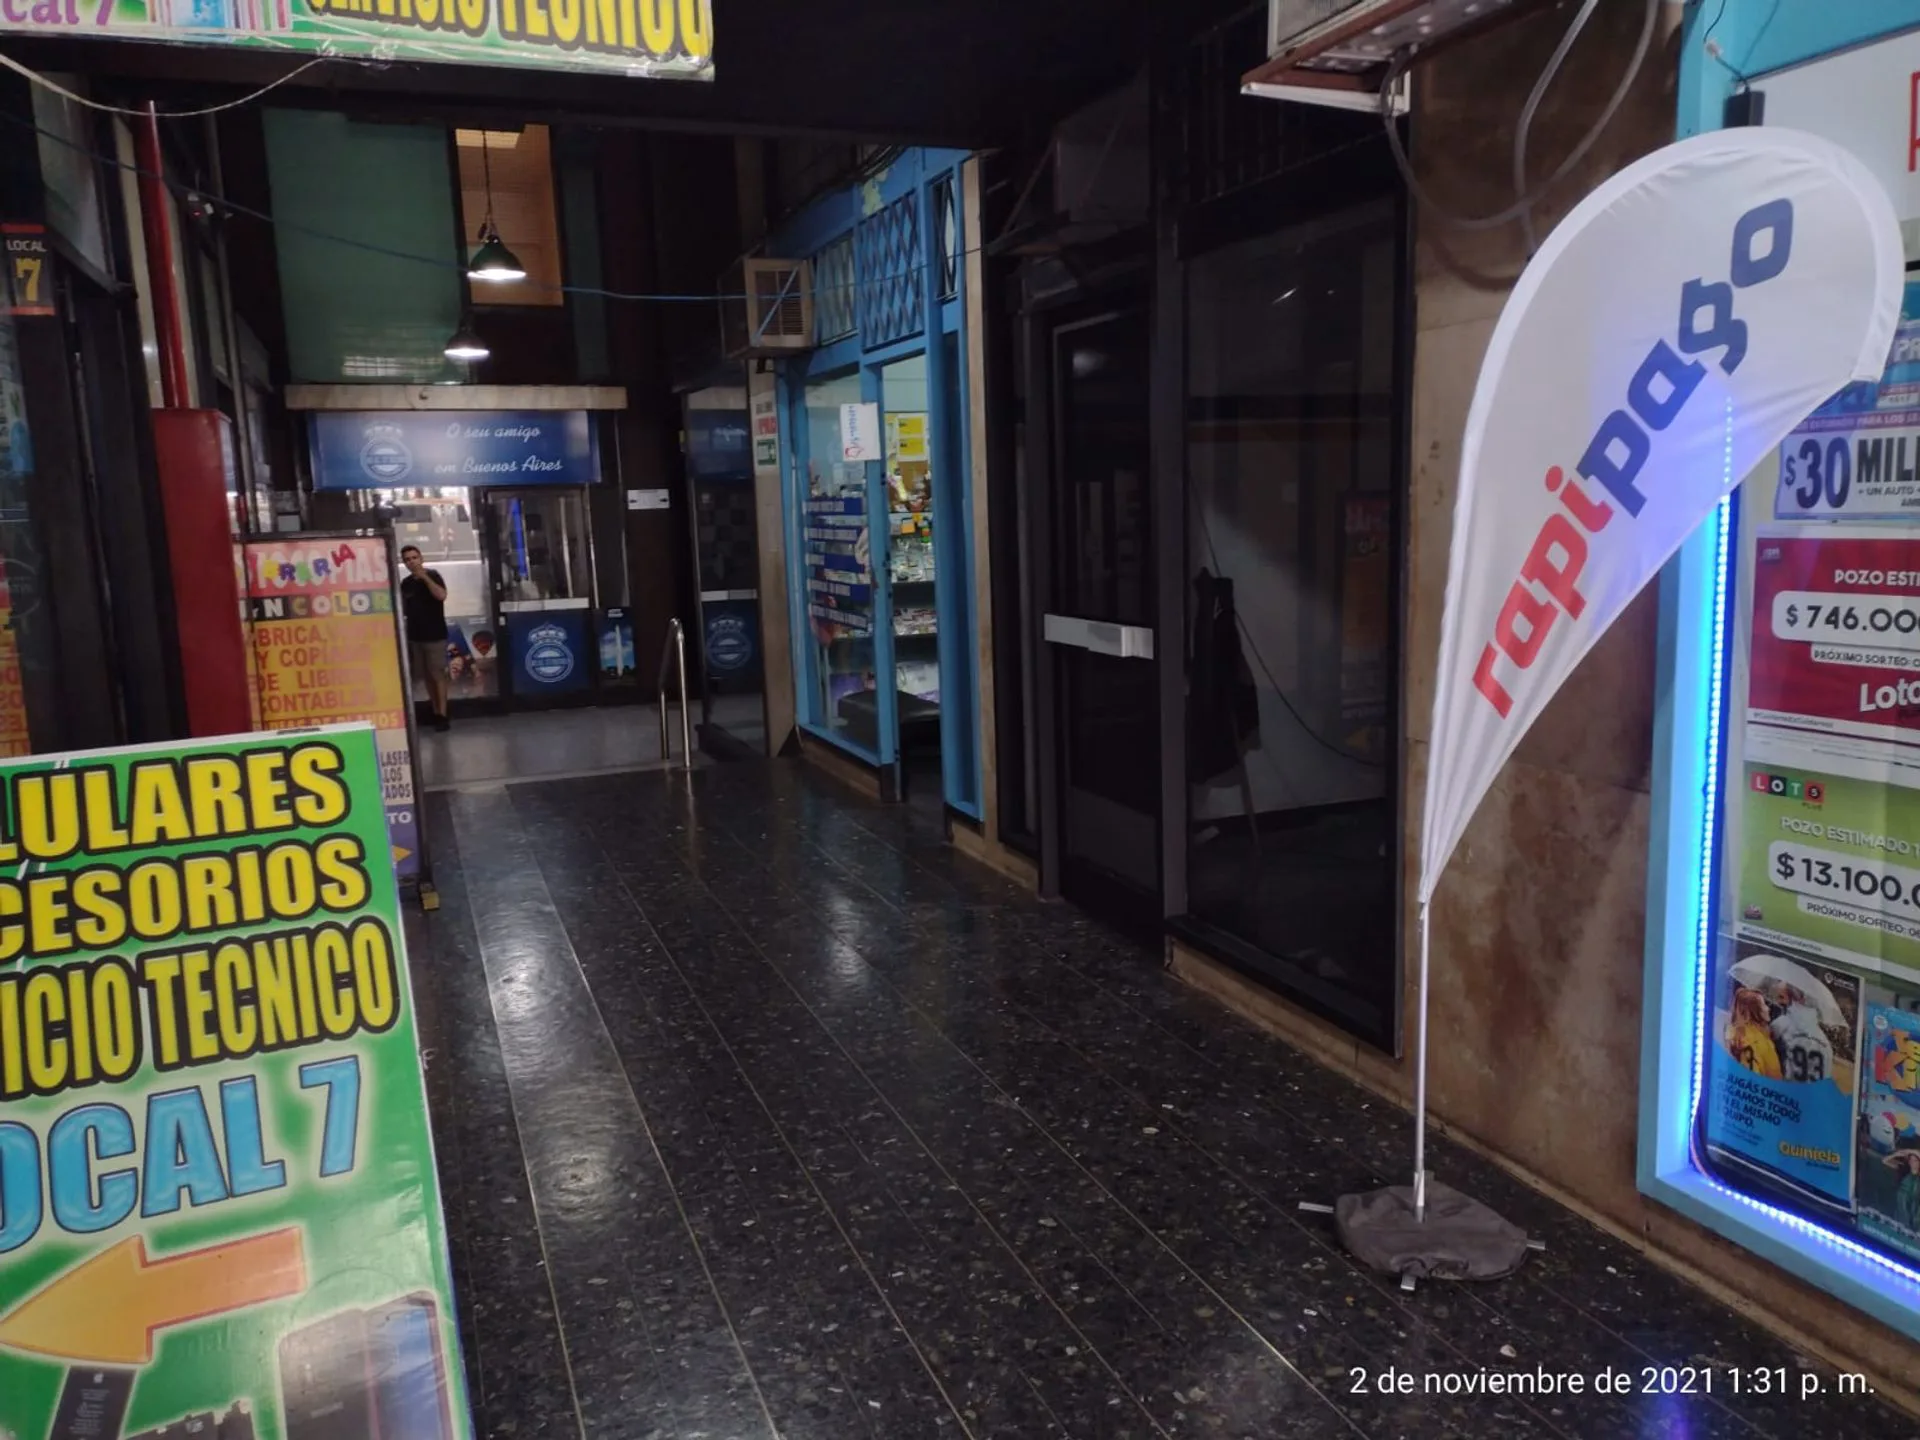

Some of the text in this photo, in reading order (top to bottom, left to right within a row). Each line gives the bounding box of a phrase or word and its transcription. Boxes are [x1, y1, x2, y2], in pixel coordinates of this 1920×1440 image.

[6, 240, 47, 252] LOCAL
[15, 258, 41, 302] 7
[494, 423, 541, 443] amigo
[463, 456, 517, 473] Buenos
[521, 455, 564, 472] Aires
[1472, 197, 1794, 720] rapipago
[1856, 435, 1920, 483] MIL
[1834, 569, 1884, 585] POZO
[291, 592, 391, 616] COLOR
[1807, 604, 1920, 633] 746.00
[1814, 649, 1863, 663] PRÓXIMO
[1781, 817, 1825, 836] POZO
[1827, 826, 1910, 854] ESTIMADO
[1806, 900, 1857, 922] PRÓXIMO
[144, 922, 393, 1066] TECNICO
[299, 1055, 361, 1178] 7
